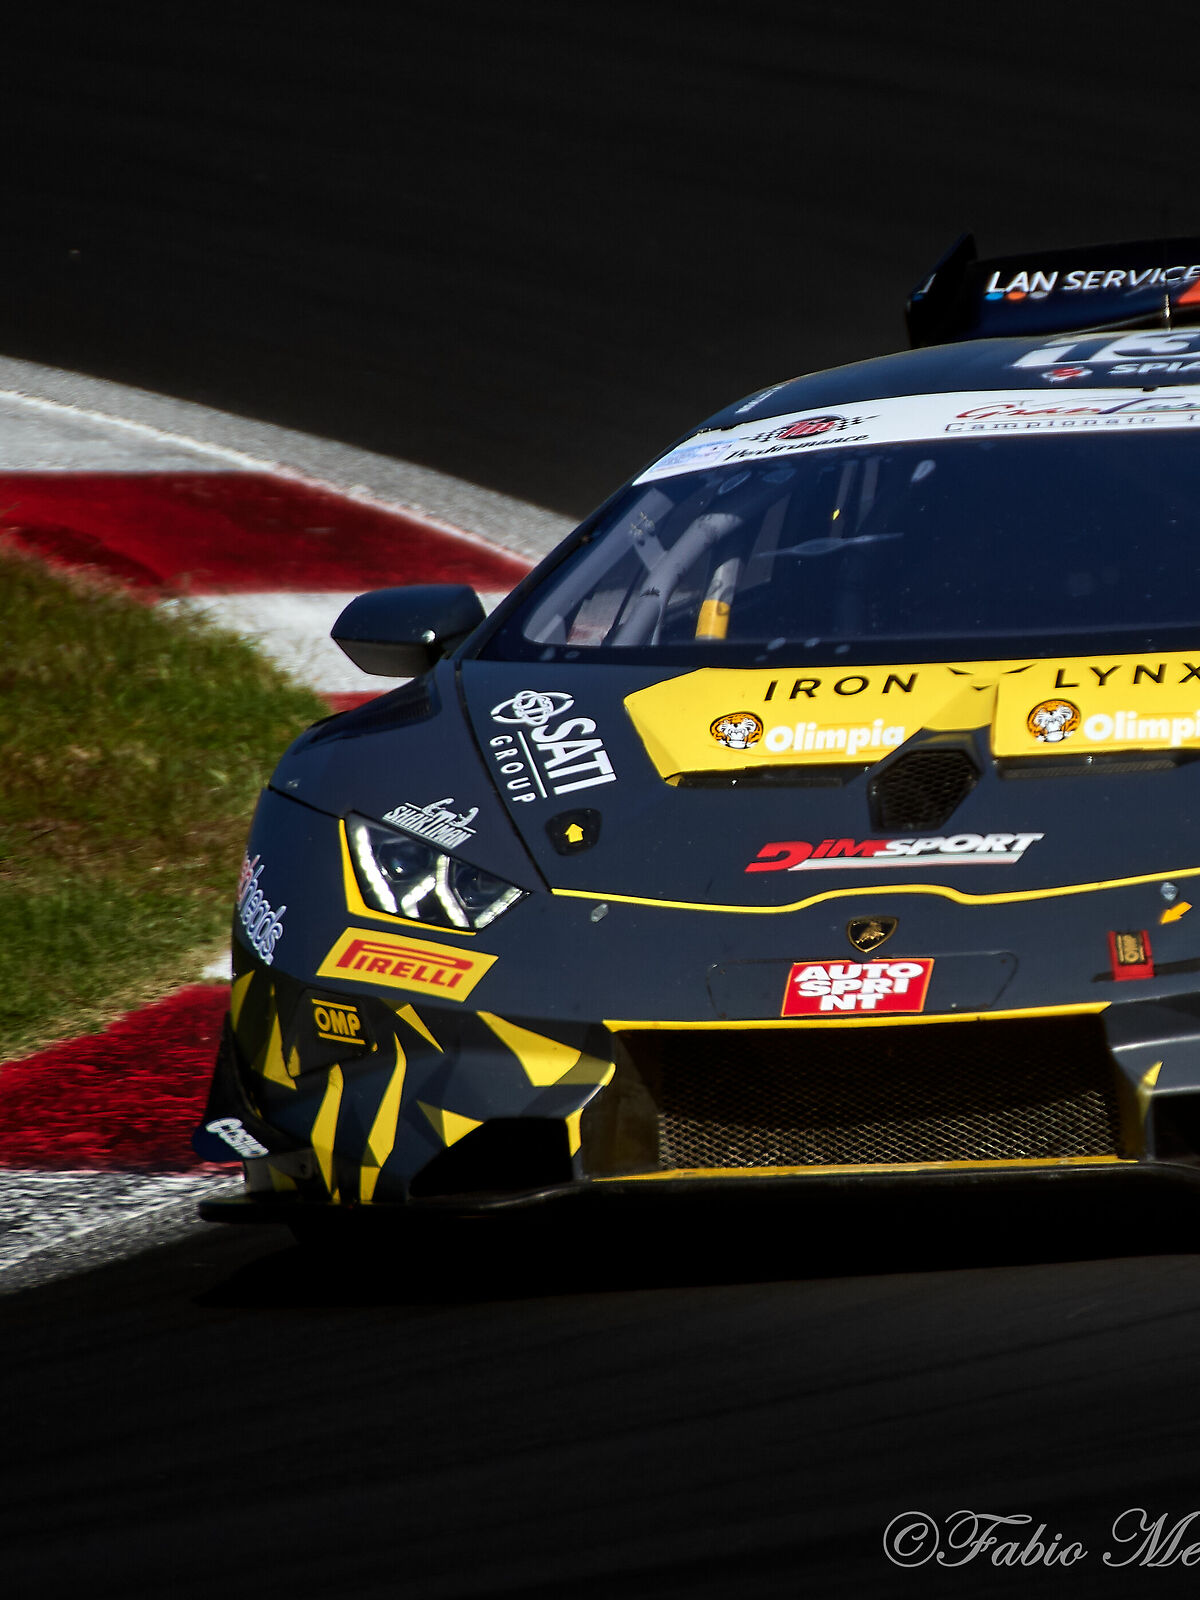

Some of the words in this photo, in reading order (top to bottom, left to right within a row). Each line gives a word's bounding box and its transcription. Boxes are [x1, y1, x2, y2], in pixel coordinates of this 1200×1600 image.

[985, 270, 1060, 293] LAN
[944, 415, 1158, 433] Campionato
[763, 672, 918, 702] IRON
[764, 718, 905, 757] Olimpia
[489, 734, 537, 803] GROUP
[530, 717, 618, 796] SATI
[335, 938, 475, 990] PIRELLI
[794, 963, 924, 983] AUTO
[799, 978, 910, 996] SPRI
[819, 994, 884, 1011] NT
[314, 1007, 361, 1038] OMP
